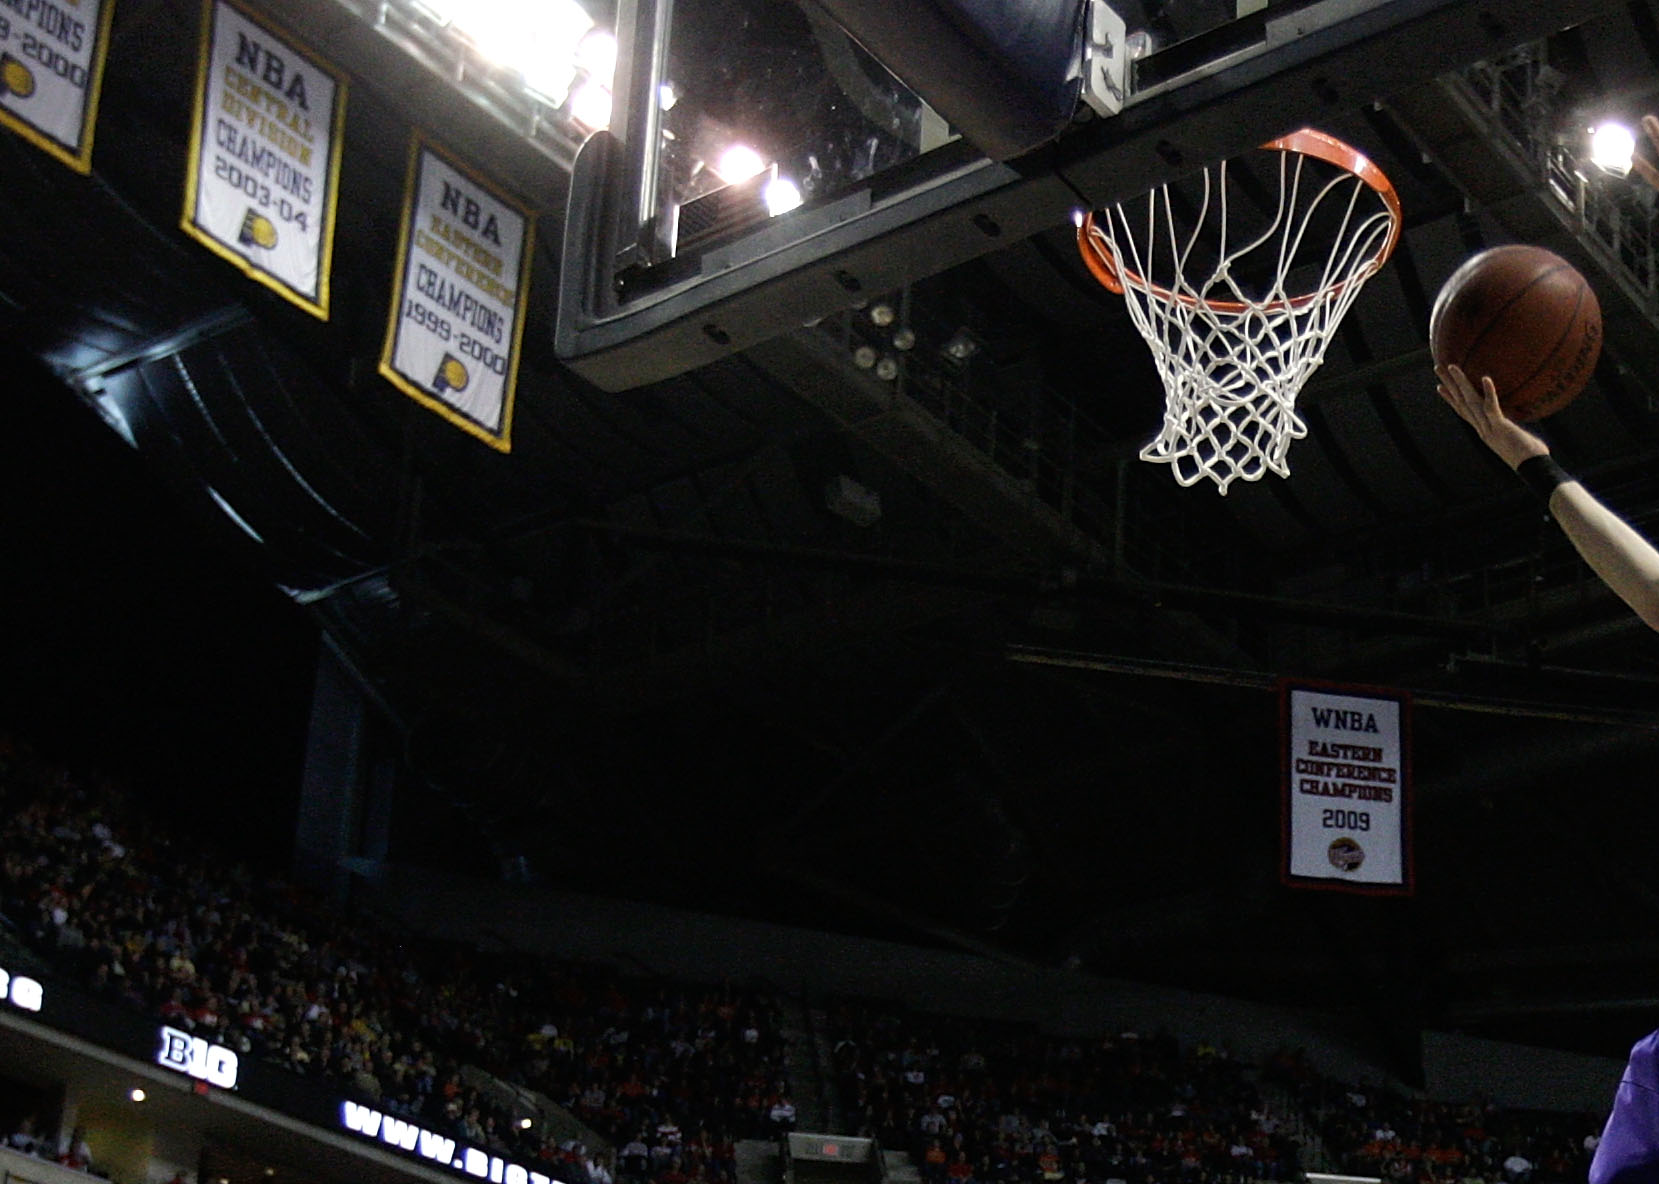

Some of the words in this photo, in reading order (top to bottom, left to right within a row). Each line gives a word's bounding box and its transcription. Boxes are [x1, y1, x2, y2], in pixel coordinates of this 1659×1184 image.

[236, 31, 309, 112] NBA
[215, 155, 308, 232] 2003-04
[216, 118, 313, 204] CHAMPIONS
[440, 180, 501, 247] NBA
[417, 263, 504, 344] CHAMPIONS
[406, 299, 507, 376] 1999-2000
[1308, 740, 1383, 763] EASTERN
[1311, 707, 1379, 733] WNBA
[1296, 759, 1396, 784] CONFERENCE
[1300, 779, 1393, 803] CHAMPIONS
[1322, 809, 1370, 831] 2009
